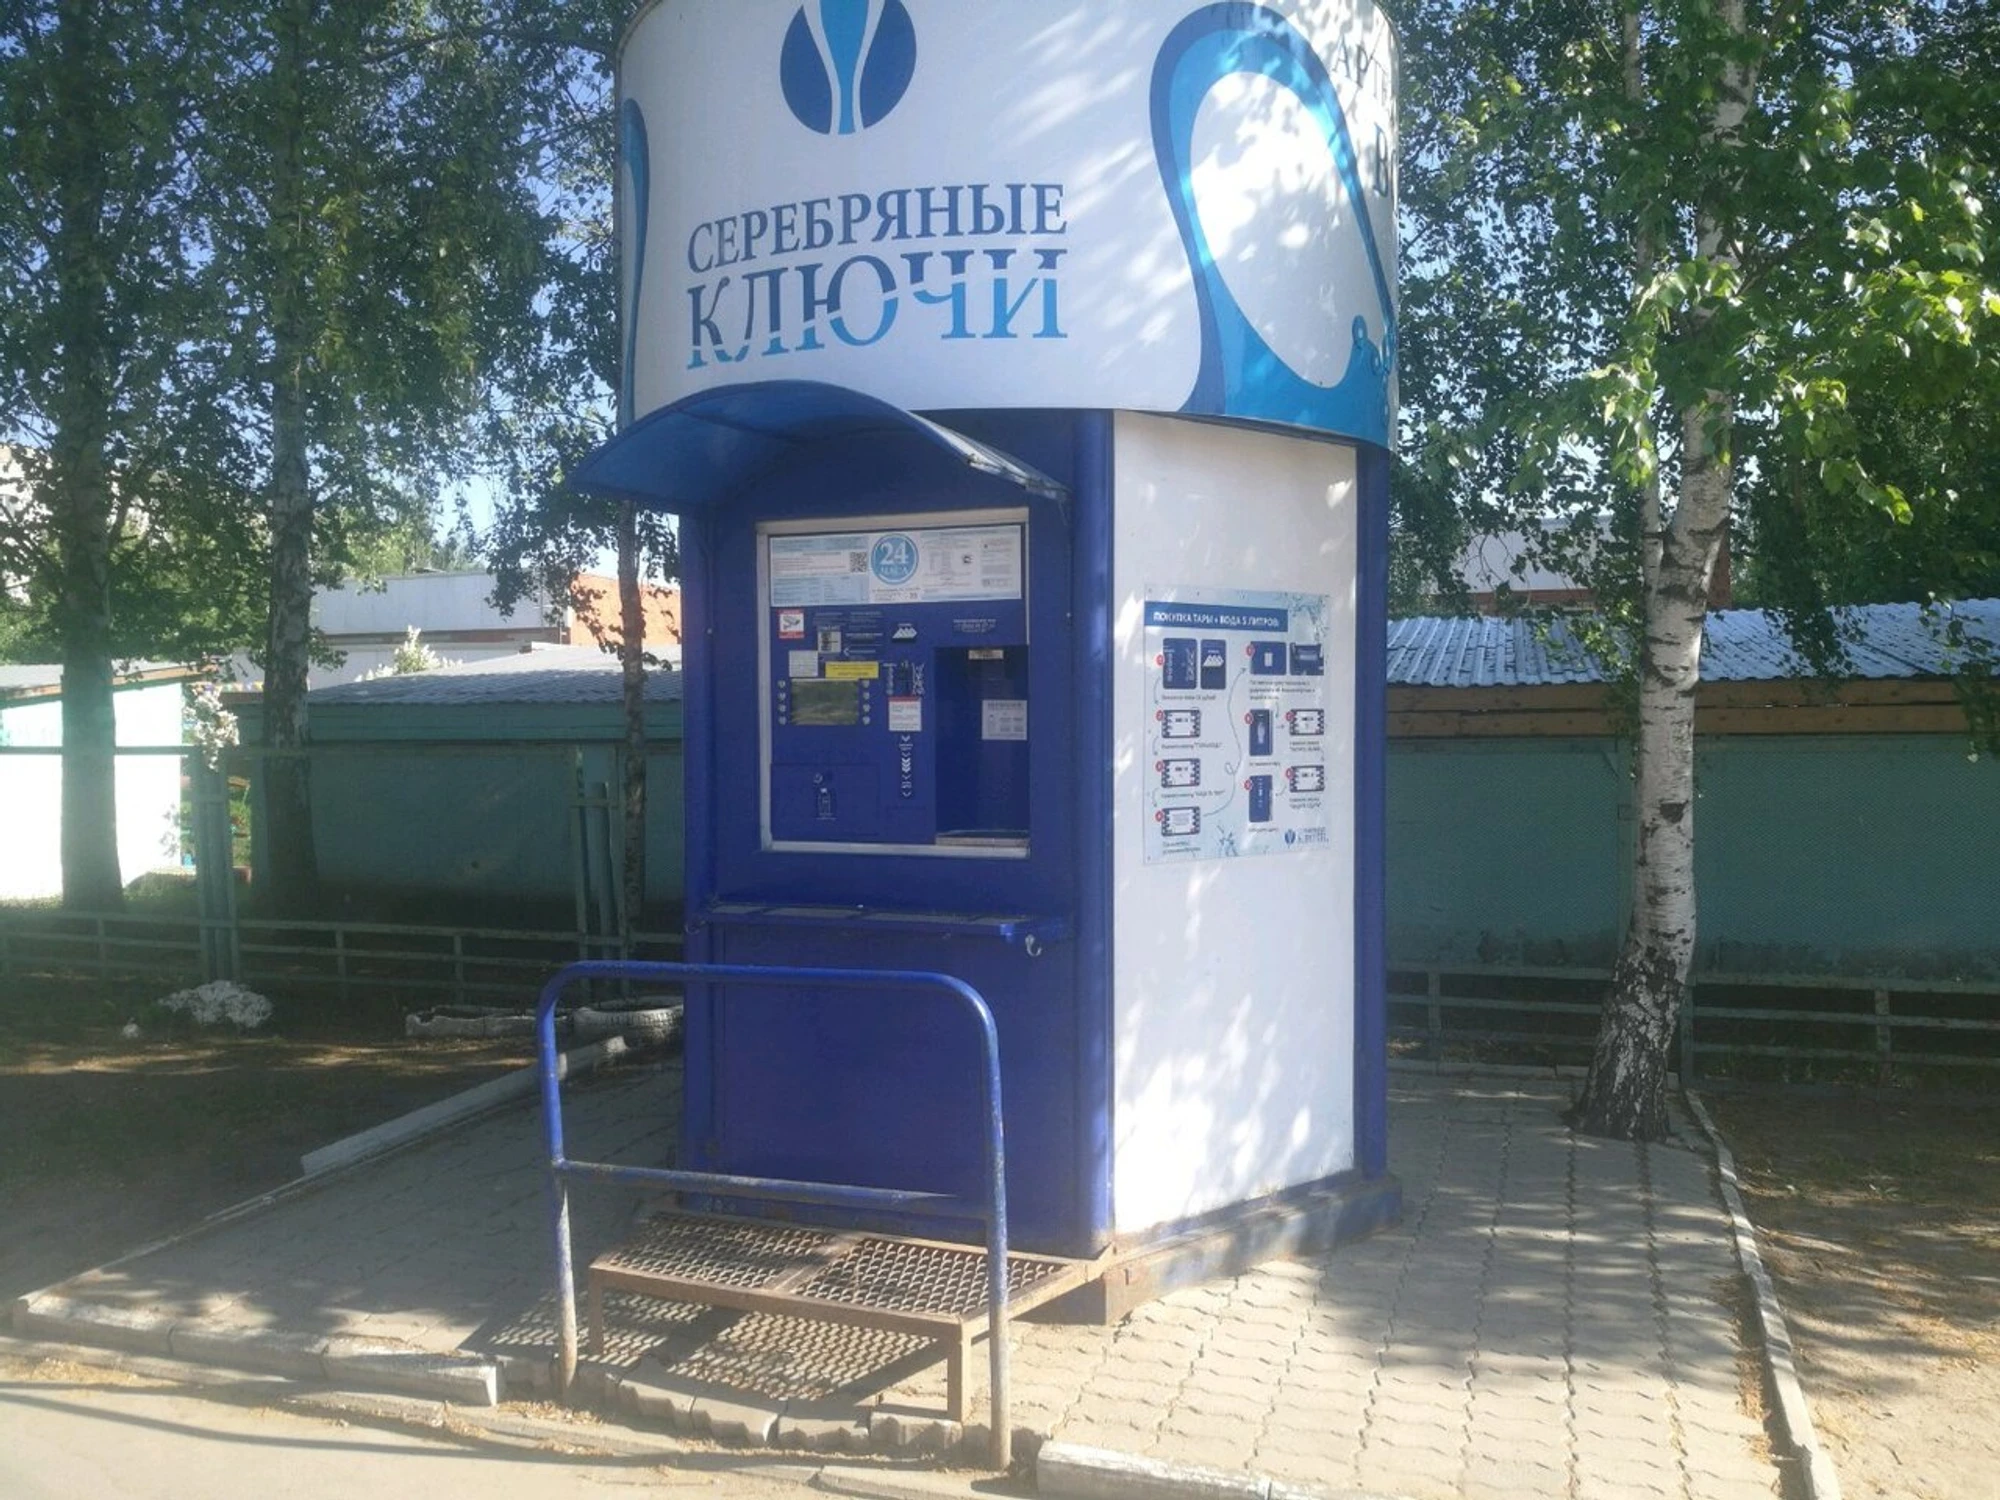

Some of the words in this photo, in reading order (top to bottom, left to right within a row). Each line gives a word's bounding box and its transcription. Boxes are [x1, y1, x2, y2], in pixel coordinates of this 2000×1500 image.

[687, 183, 1068, 274] СЕРЕБРЯНЫЕ
[686, 248, 1068, 369] КЛЮЧИ
[880, 541, 909, 565] 24
[1153, 611, 1192, 623] ПОКУПКА
[1193, 613, 1214, 624] ТАРЫ
[1220, 615, 1241, 626] ВОДА
[1248, 617, 1280, 627] ЛИТРОВ
